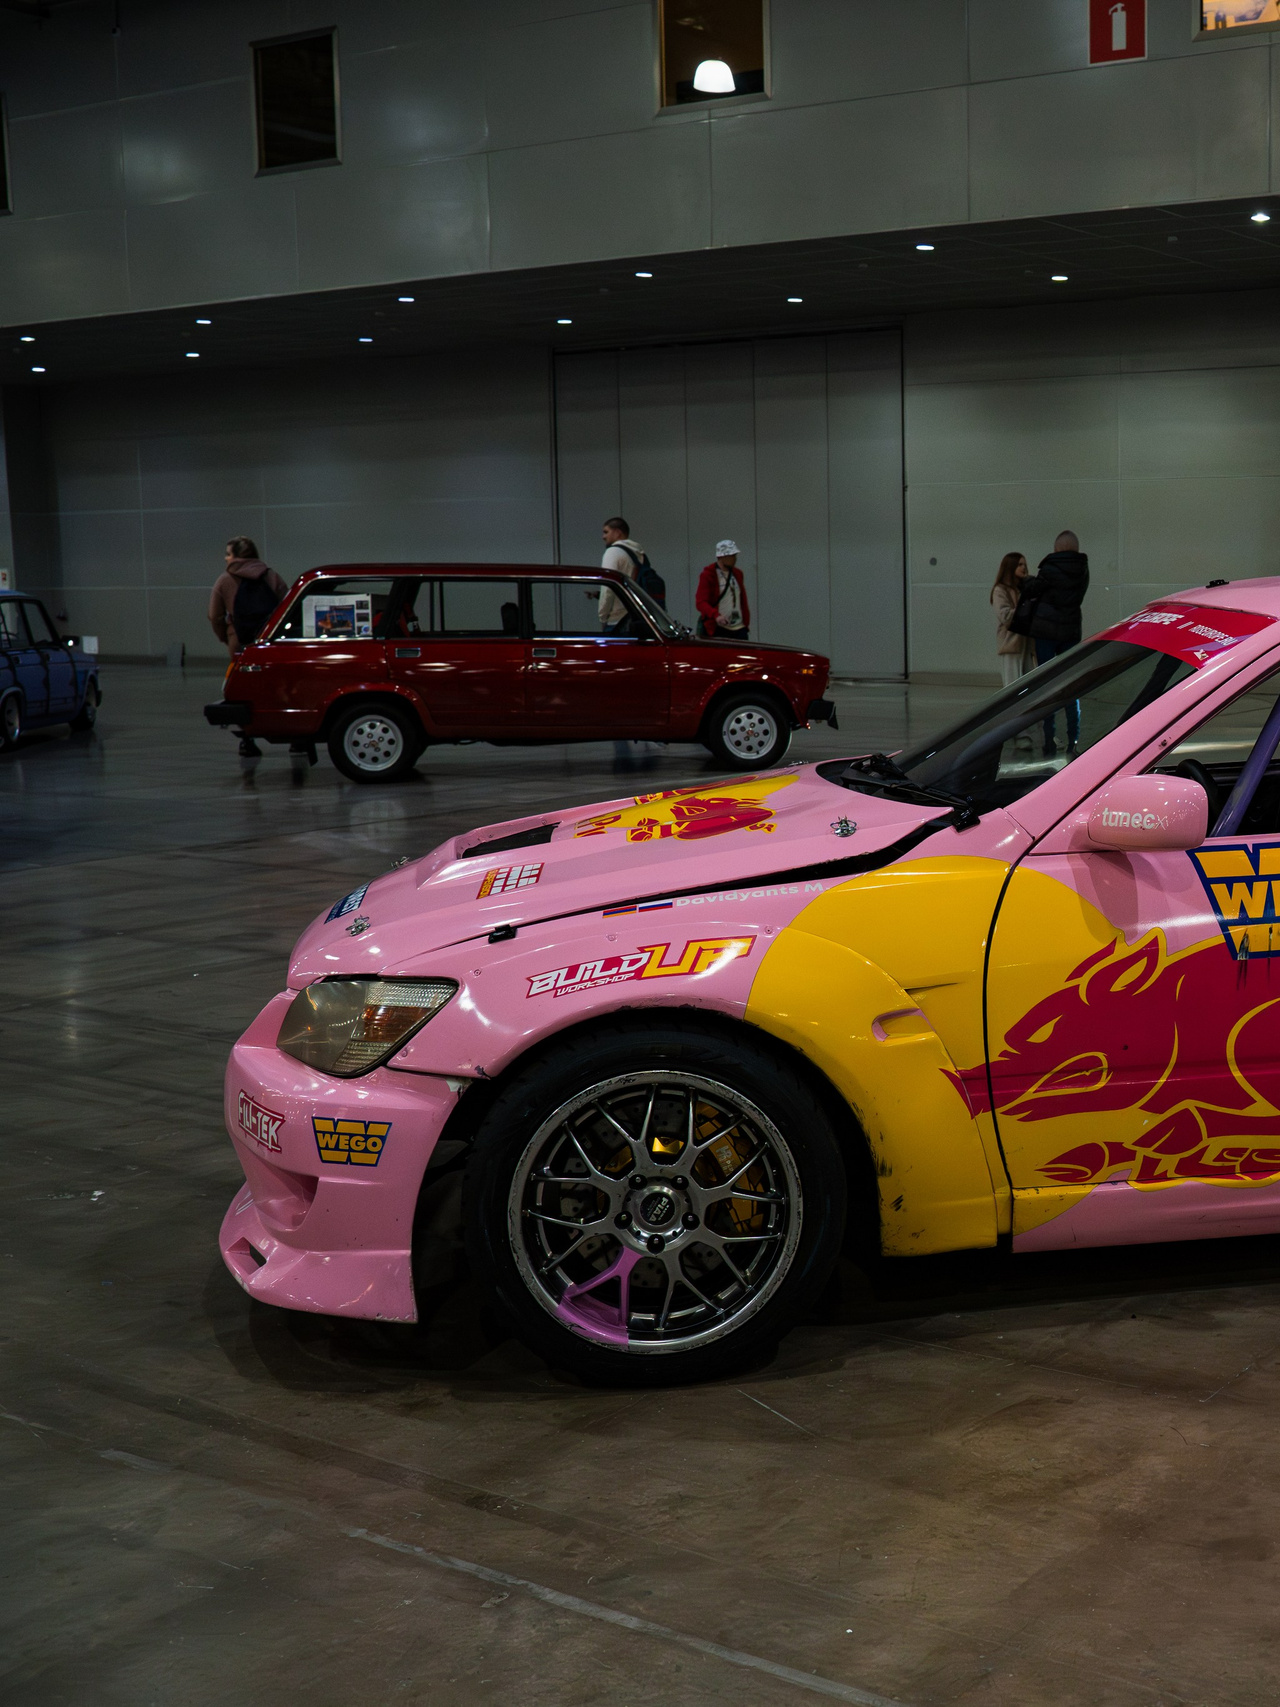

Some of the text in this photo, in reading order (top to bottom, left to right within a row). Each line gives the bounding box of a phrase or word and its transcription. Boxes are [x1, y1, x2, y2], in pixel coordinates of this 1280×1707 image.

[676, 883, 799, 907] Davidyants
[555, 972, 636, 997] WORKSHOP
[316, 1132, 382, 1153] WEGO
